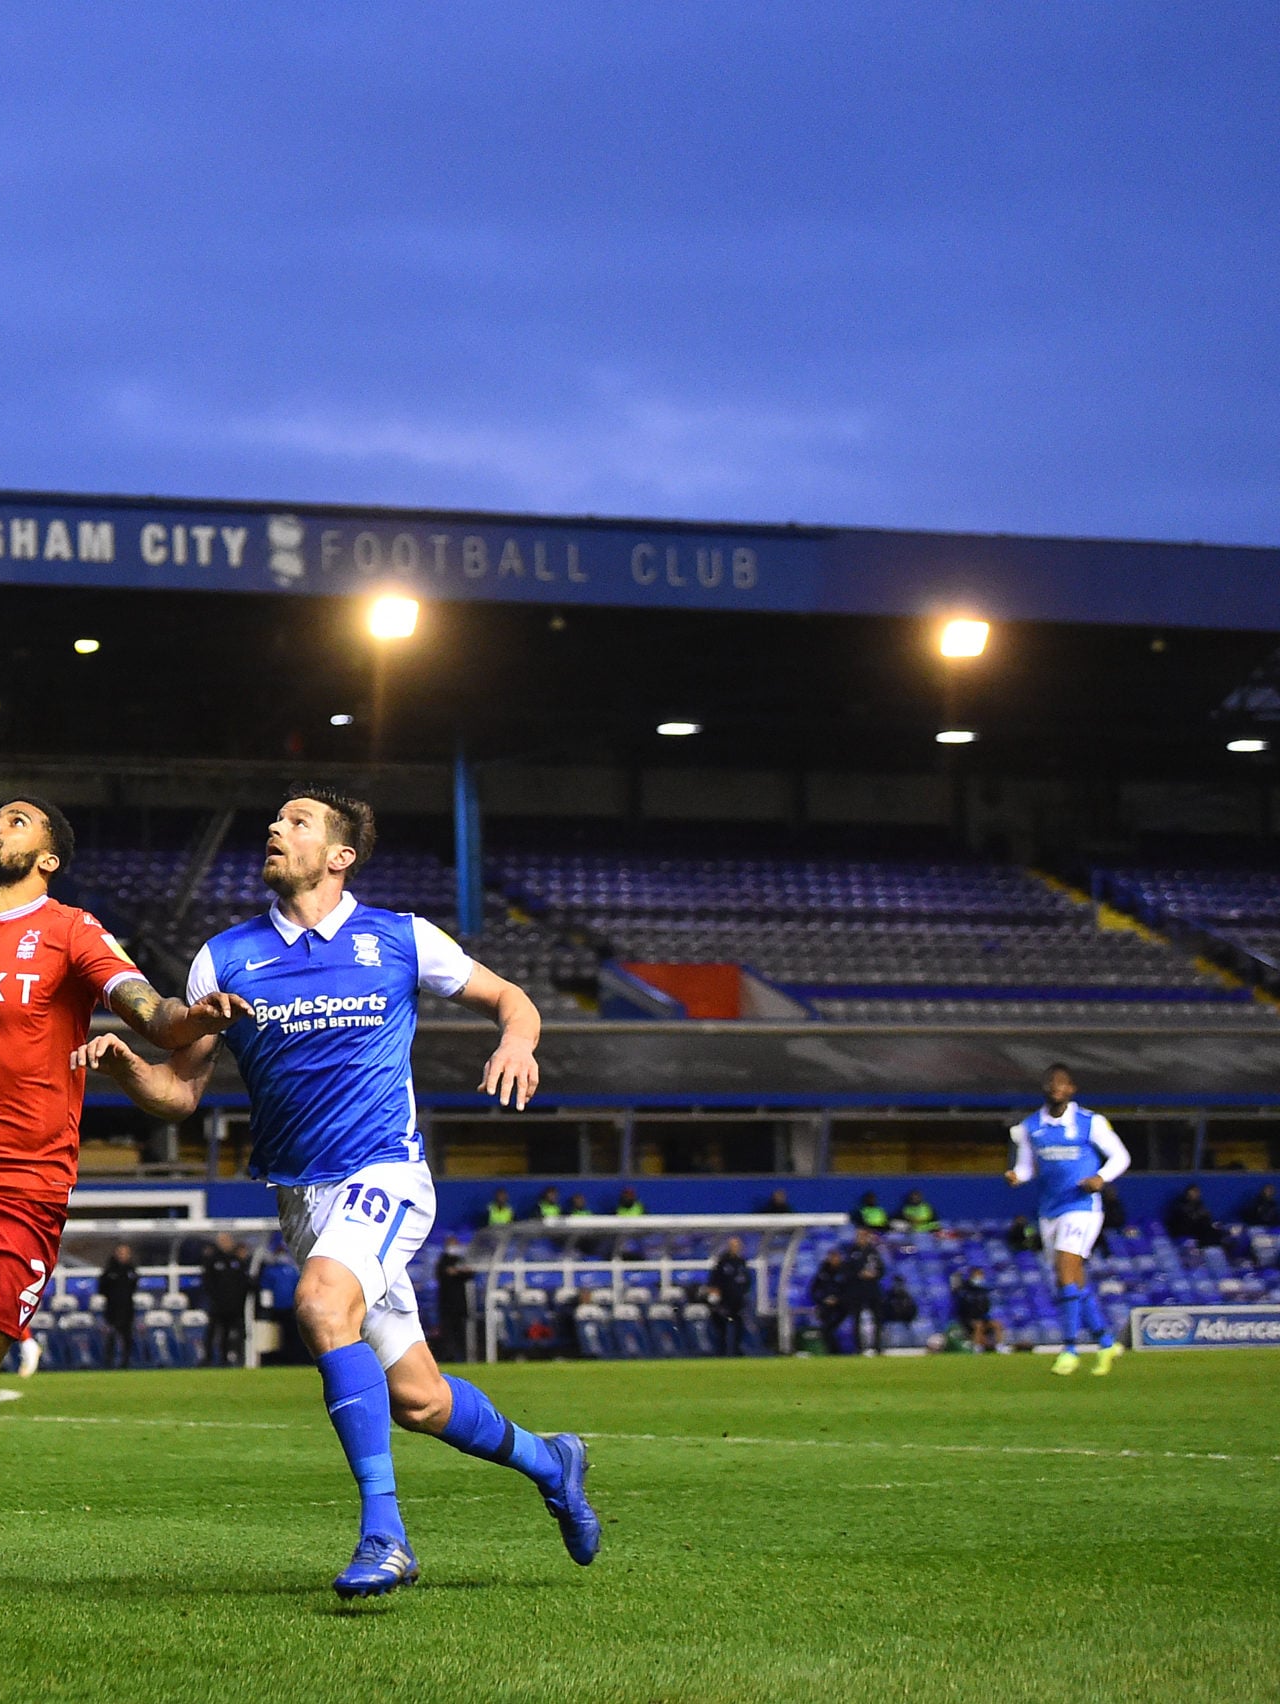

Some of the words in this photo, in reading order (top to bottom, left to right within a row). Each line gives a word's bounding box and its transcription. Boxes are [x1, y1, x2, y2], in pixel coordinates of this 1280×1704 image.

[140, 522, 248, 568] CITY
[321, 530, 589, 583] FOOTBALL
[631, 542, 758, 589] CLUB
[255, 993, 387, 1023] BoyleSports
[281, 1020, 312, 1034] THIS
[314, 1018, 326, 1029] IS
[343, 1183, 390, 1223] 10
[19, 1258, 46, 1306] 2
